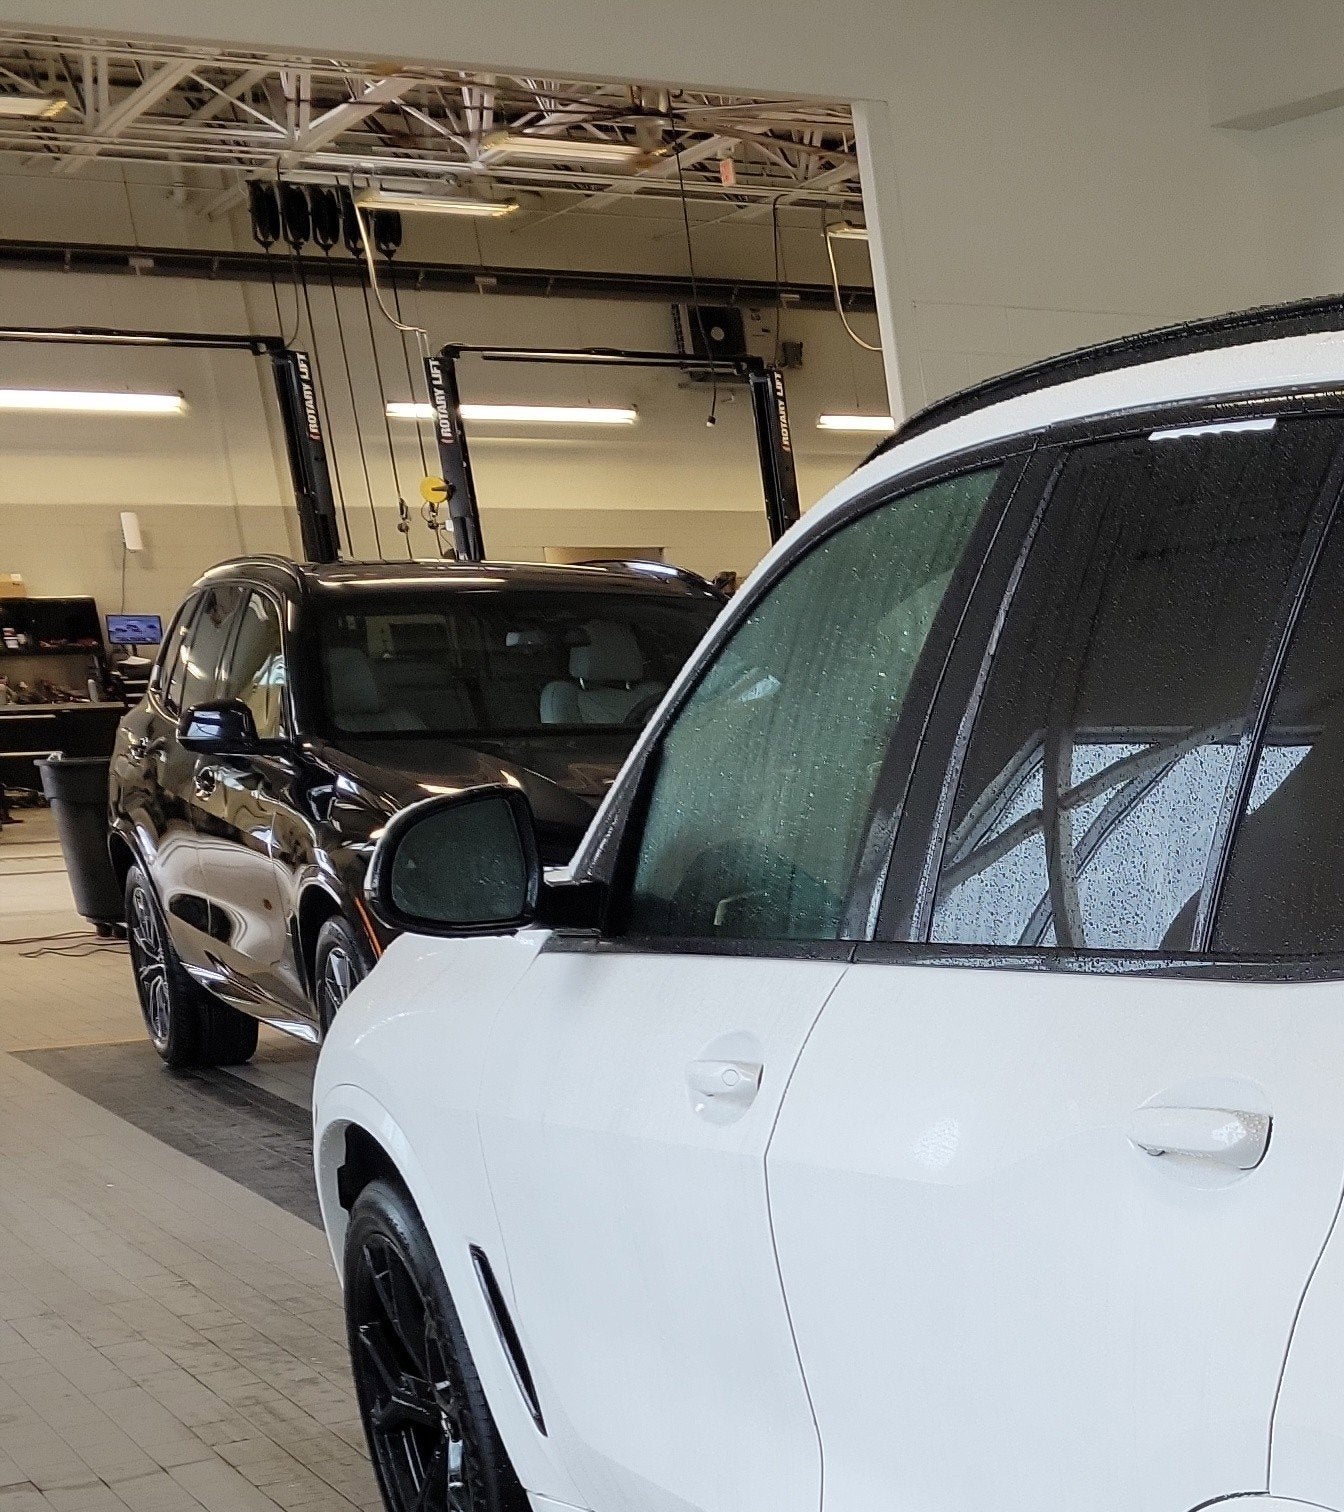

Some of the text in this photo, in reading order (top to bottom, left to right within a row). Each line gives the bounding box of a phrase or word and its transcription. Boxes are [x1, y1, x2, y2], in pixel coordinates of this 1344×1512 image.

[296, 352, 320, 433] ROTARY LIFT
[428, 358, 453, 437] ROTARY LIFT
